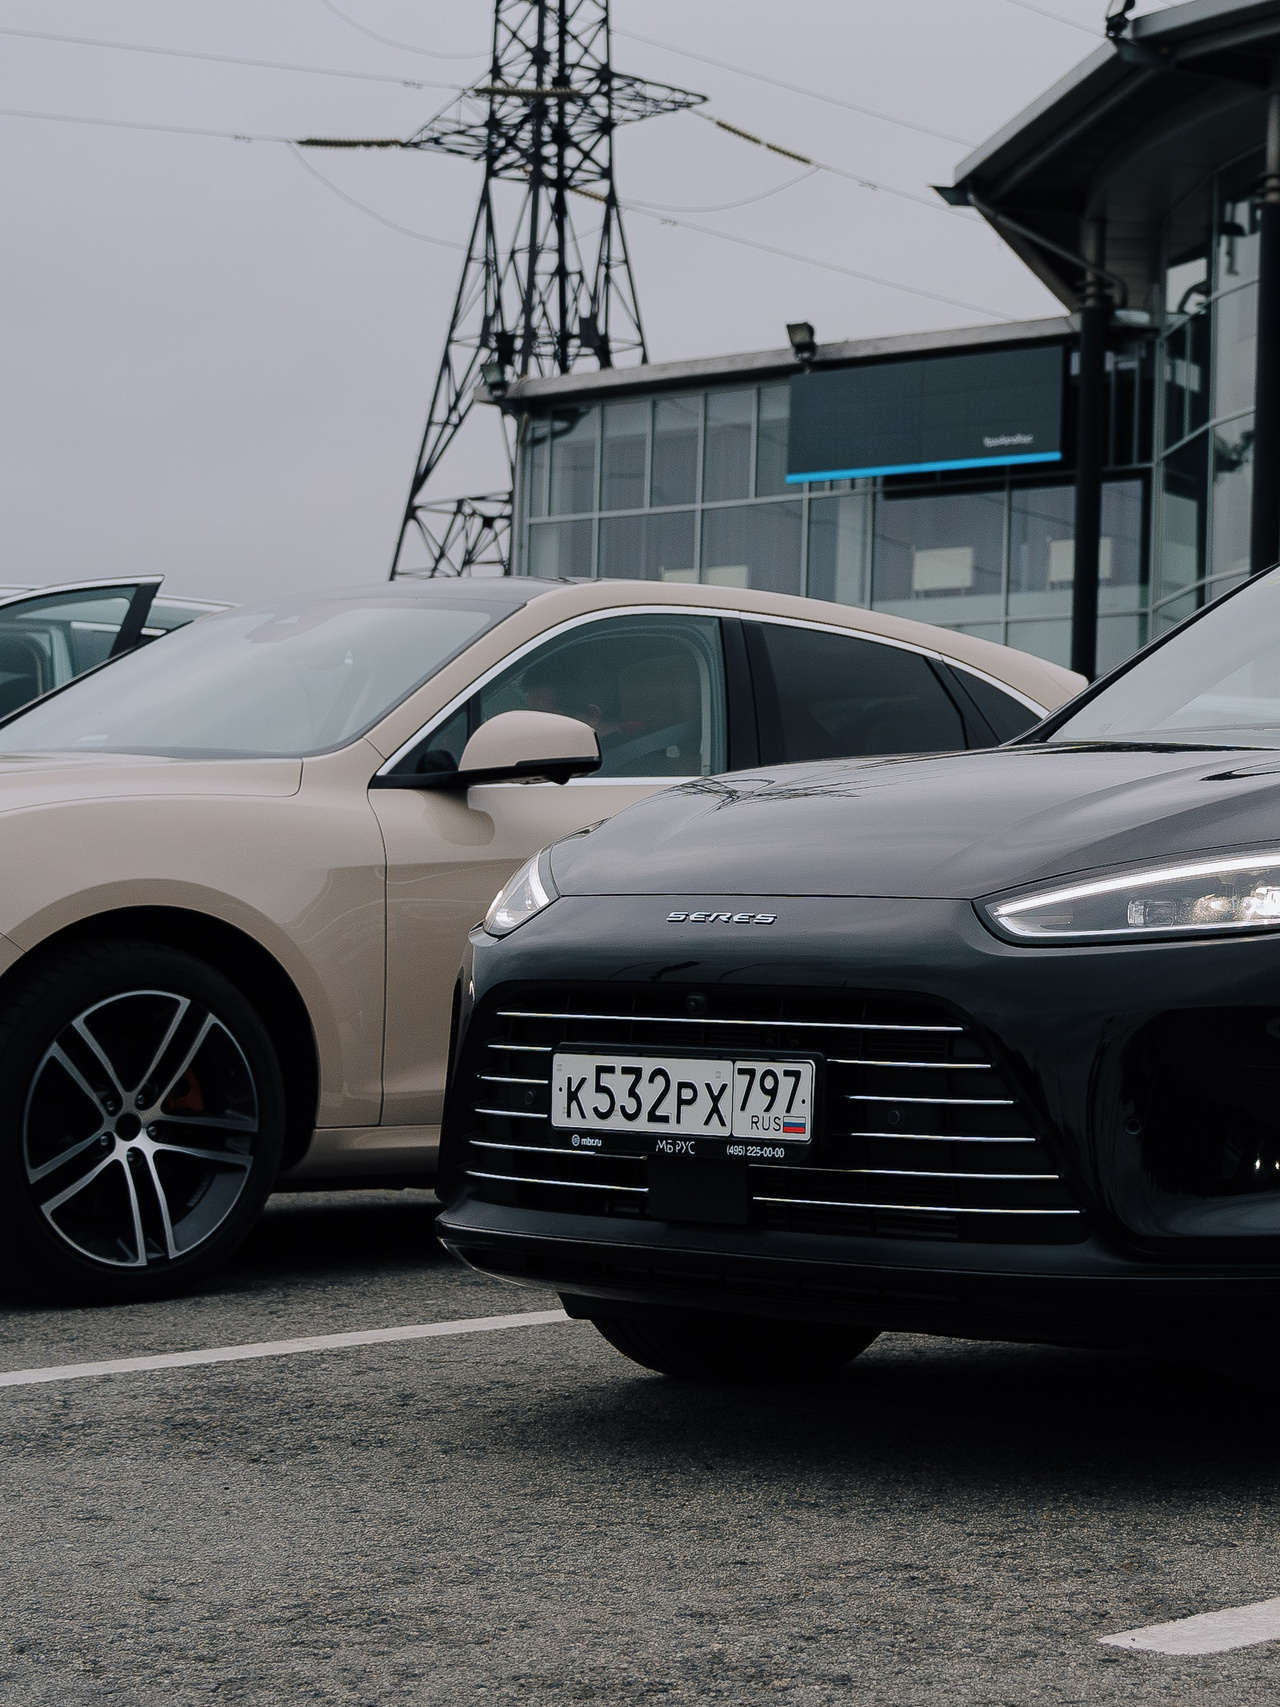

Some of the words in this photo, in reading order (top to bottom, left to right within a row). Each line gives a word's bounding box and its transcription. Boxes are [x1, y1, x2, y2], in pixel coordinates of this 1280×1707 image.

[666, 911, 777, 925] SERES
[737, 1067, 801, 1114] 797
[750, 1115, 782, 1132] RUS
[581, 1137, 602, 1147] mbr.ru
[675, 1140, 695, 1154] РУС
[726, 1144, 746, 1156] (495)
[746, 1146, 785, 1158] 225-00-00
